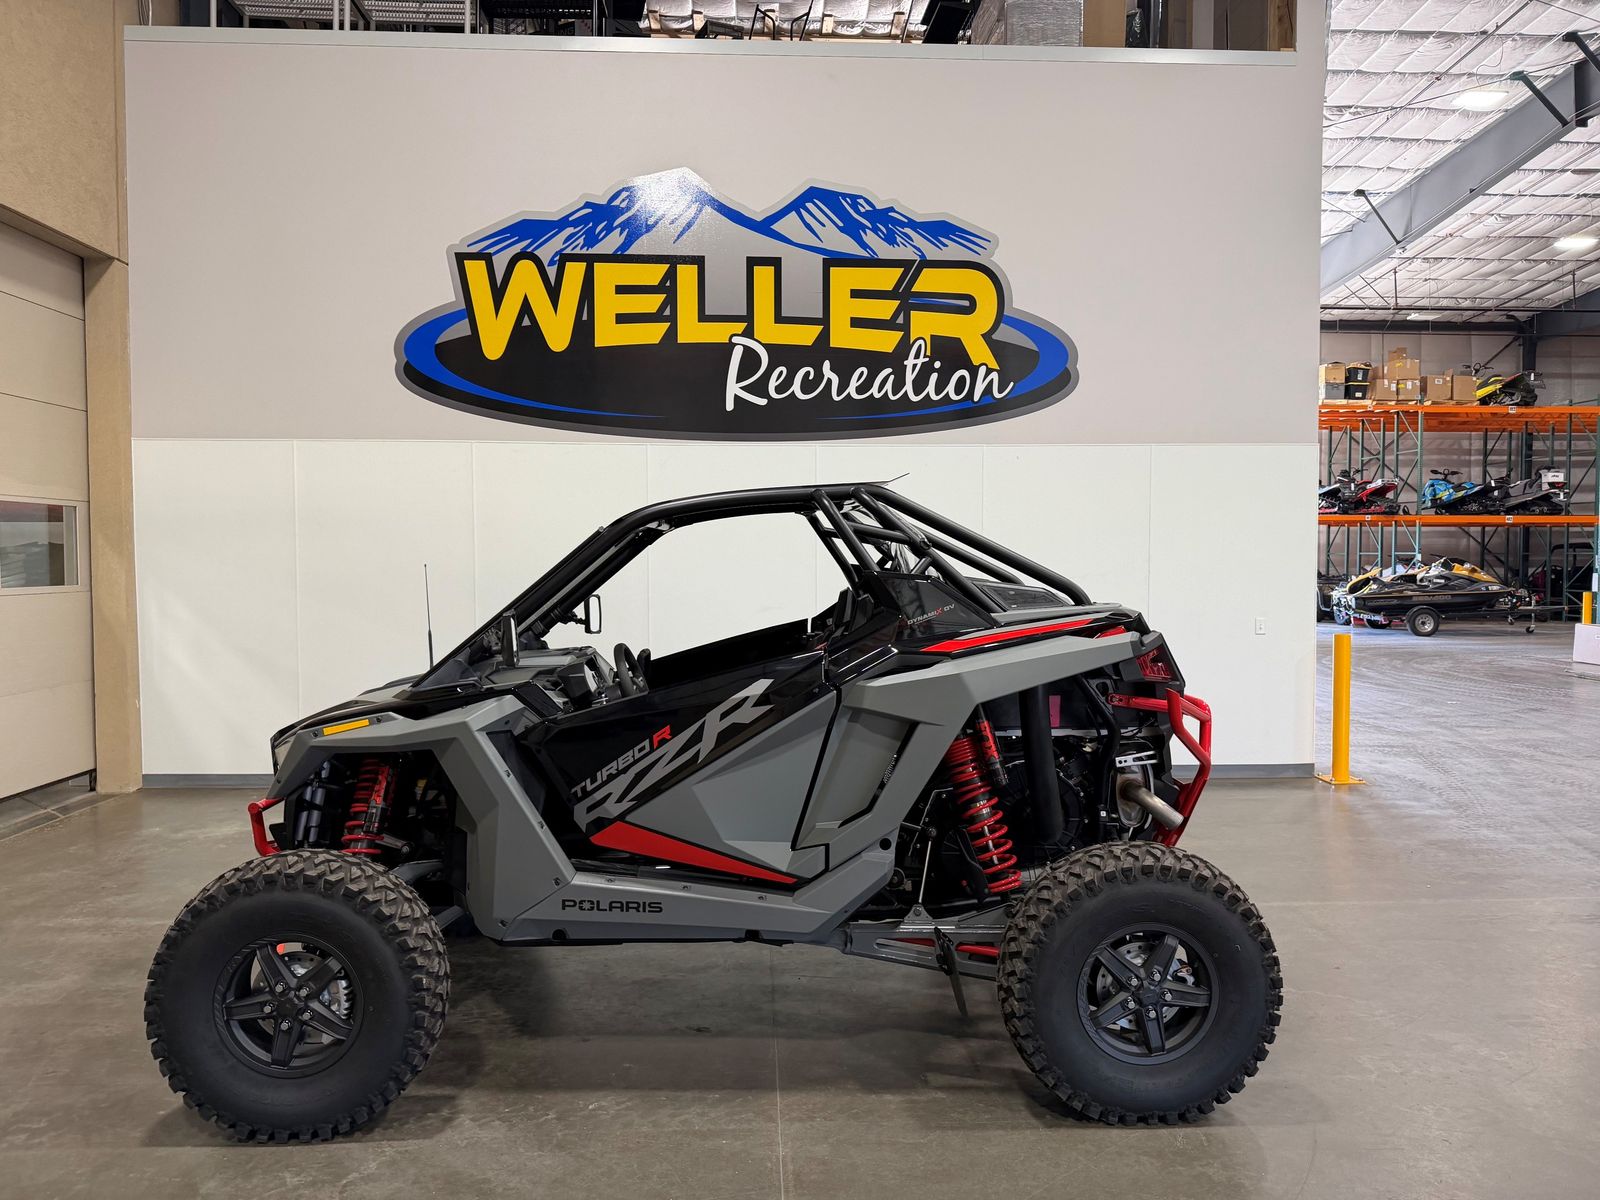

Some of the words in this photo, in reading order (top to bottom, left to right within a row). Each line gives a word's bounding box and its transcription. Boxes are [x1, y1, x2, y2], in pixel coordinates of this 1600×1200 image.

[463, 260, 1000, 369] WELLER
[725, 335, 1014, 411] Recreation
[907, 607, 942, 624] DYNAMIX
[570, 738, 651, 798] TURBO
[652, 724, 673, 750] R
[573, 678, 776, 834] RZR
[561, 898, 664, 913] POLARIS
